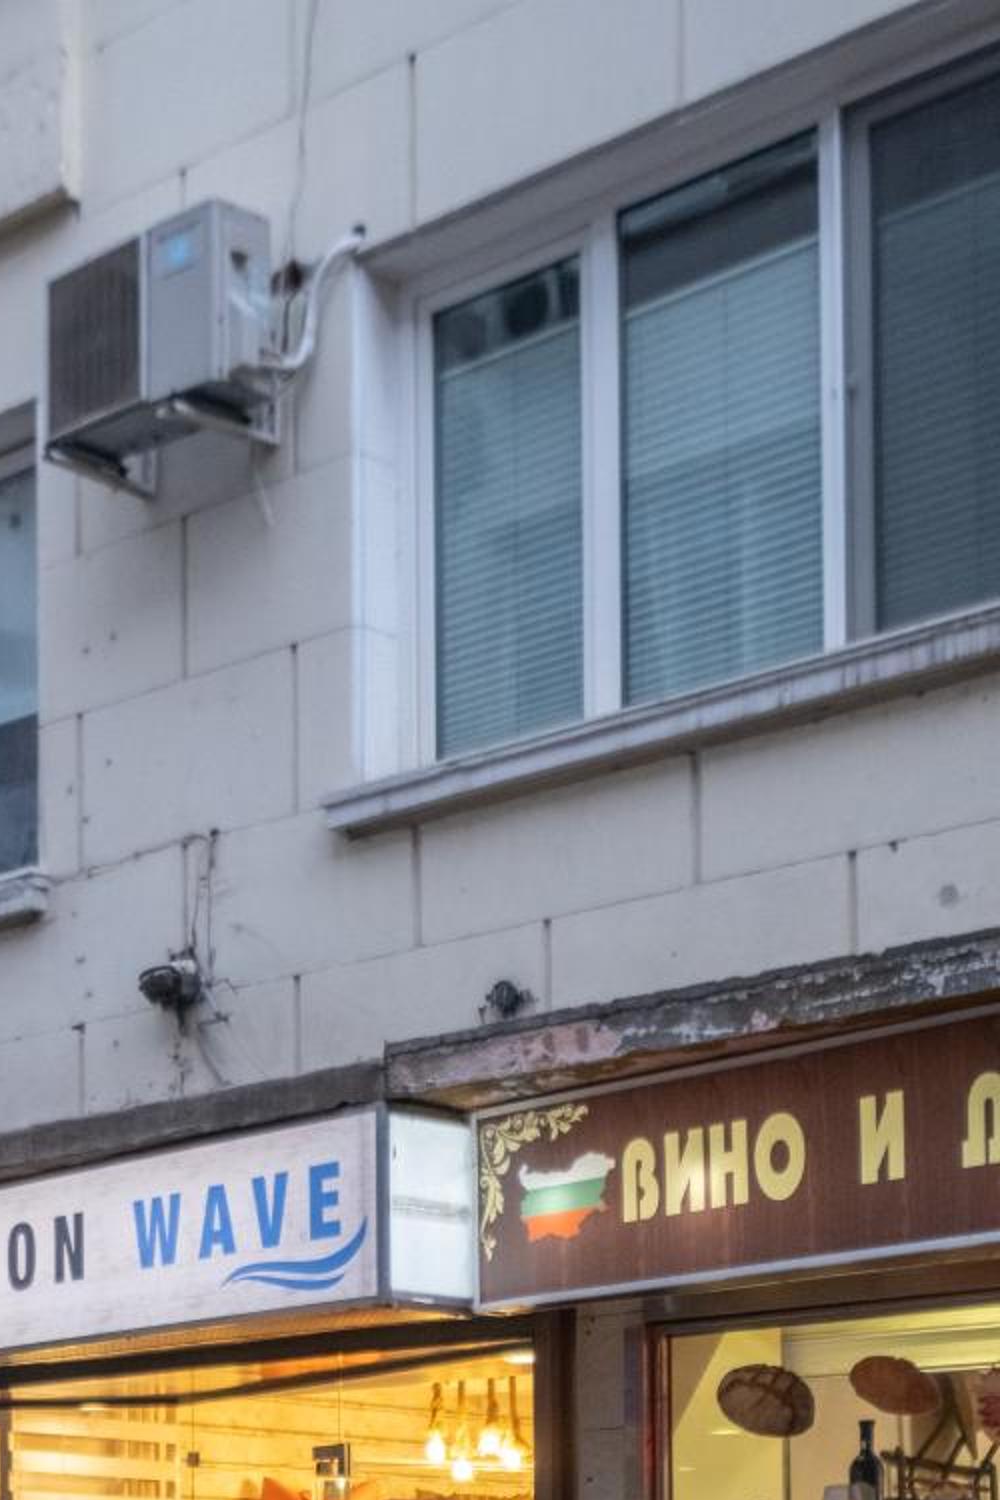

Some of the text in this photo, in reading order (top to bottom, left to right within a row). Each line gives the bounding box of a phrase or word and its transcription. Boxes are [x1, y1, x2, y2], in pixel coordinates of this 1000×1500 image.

[132, 1160, 341, 1269] WAVE
[621, 1112, 806, 1224] ВИНО
[859, 1089, 905, 1185] И
